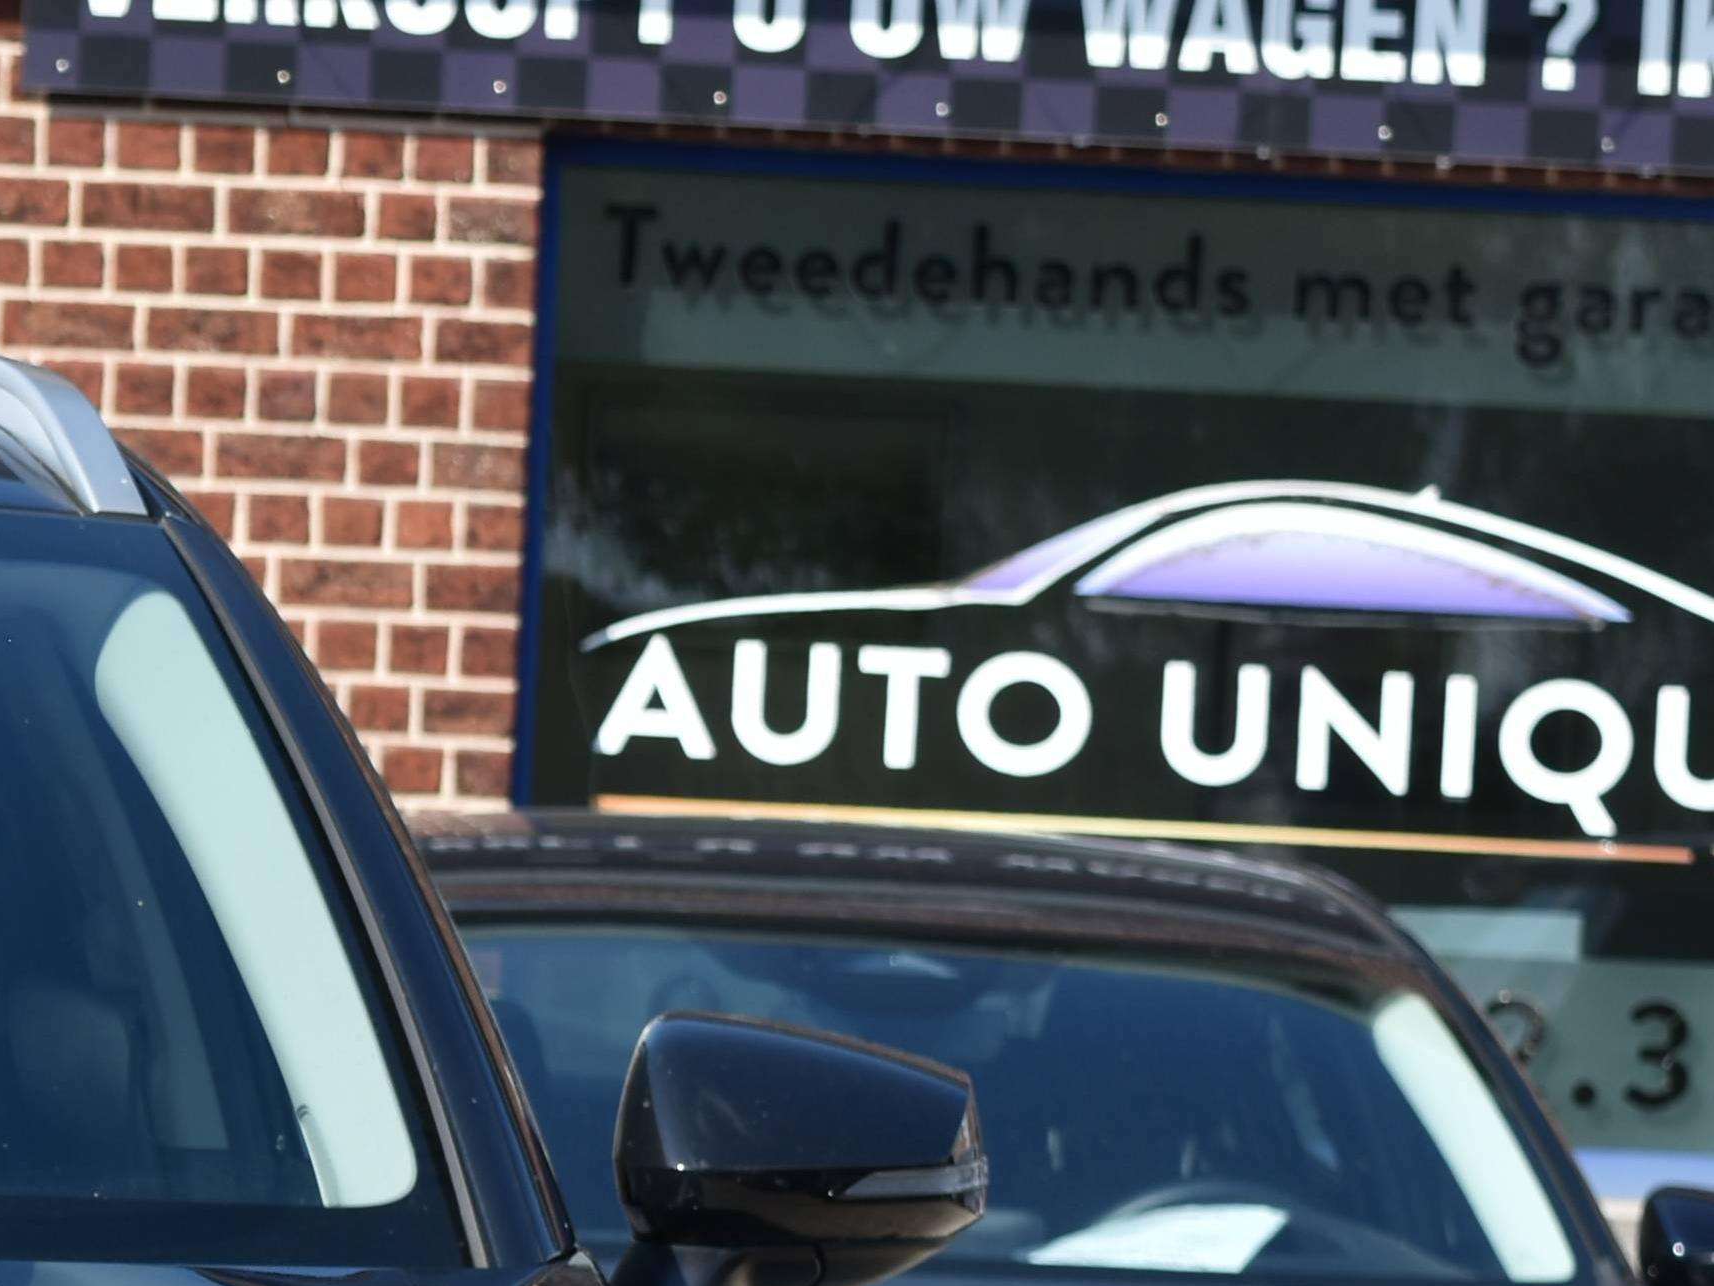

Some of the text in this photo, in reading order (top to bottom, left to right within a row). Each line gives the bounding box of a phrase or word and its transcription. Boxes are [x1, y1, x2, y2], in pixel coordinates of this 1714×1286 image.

[1081, 0, 1487, 87] WAGEN
[604, 203, 1252, 318] Tweedehands
[1294, 264, 1478, 328] met
[597, 634, 1093, 779] AUTO
